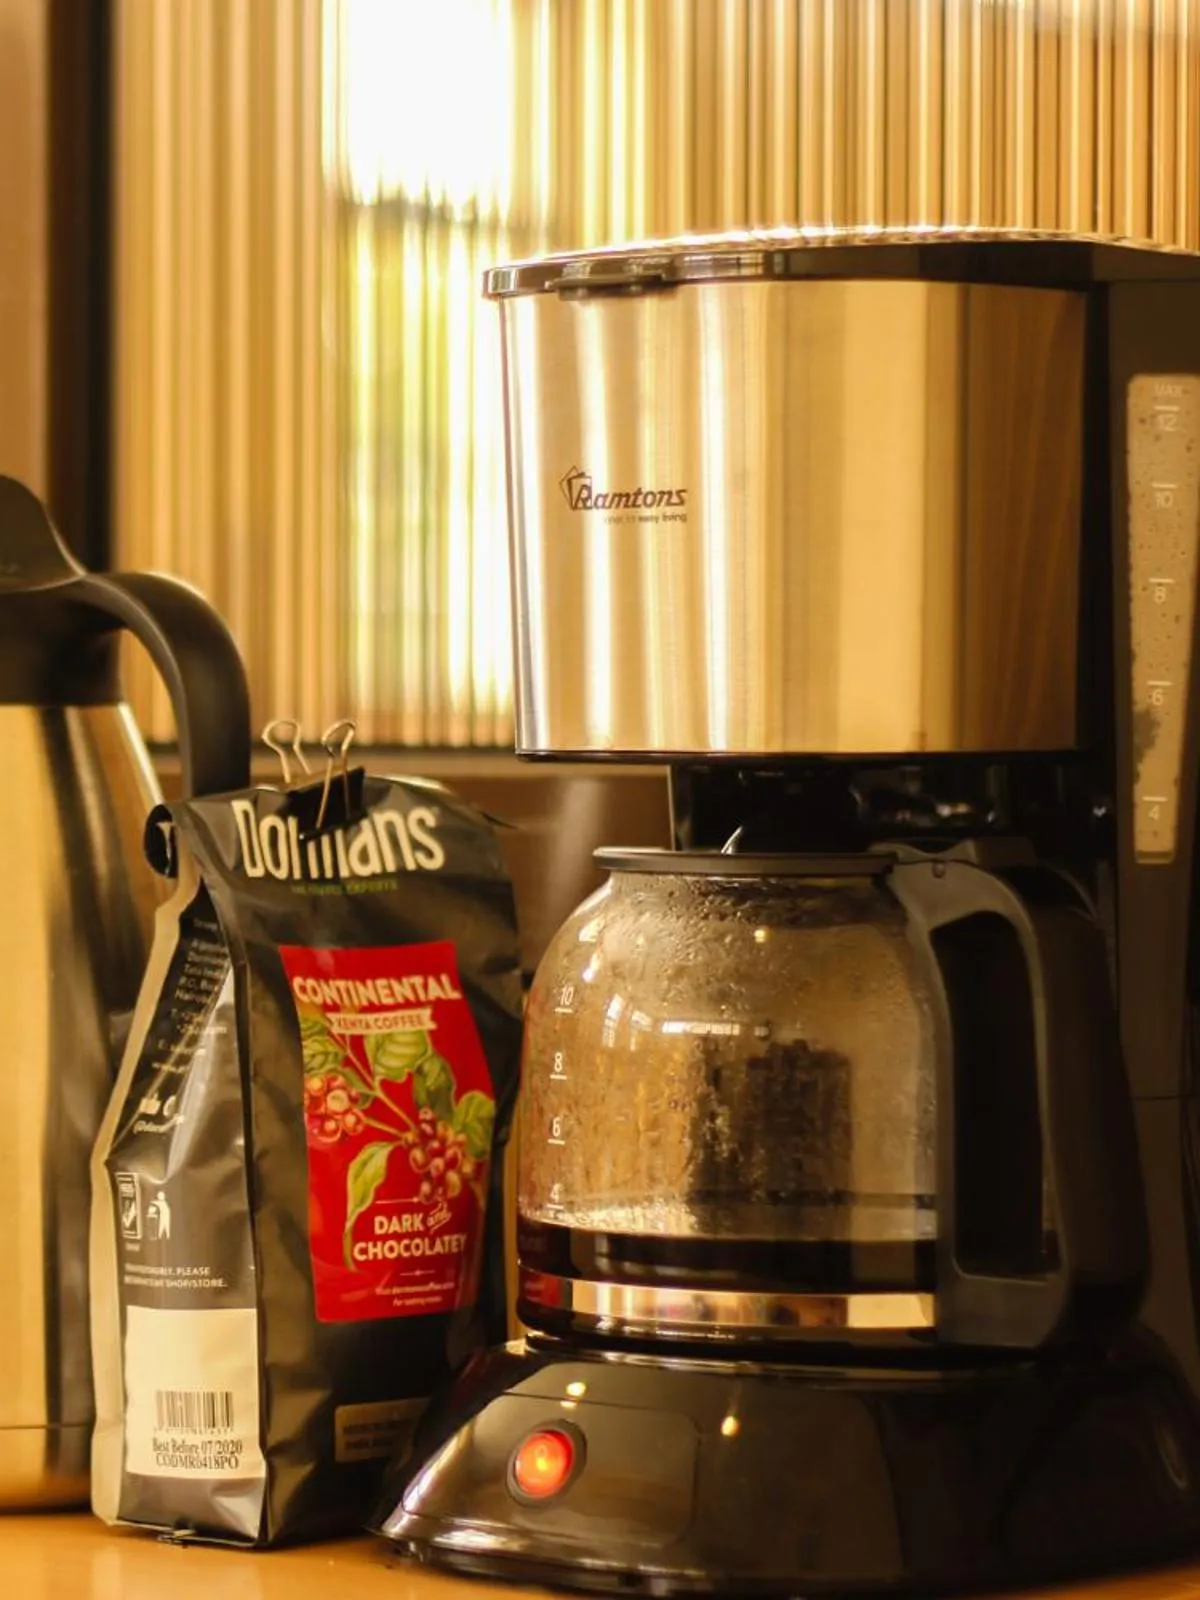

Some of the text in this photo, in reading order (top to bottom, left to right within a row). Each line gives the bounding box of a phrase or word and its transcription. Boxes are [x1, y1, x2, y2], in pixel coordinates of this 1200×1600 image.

[1157, 414, 1177, 432] 12
[573, 484, 687, 511] Ramtons
[1155, 491, 1173, 507] 10
[1154, 586, 1166, 604] 8
[1152, 689, 1164, 706] 6
[1149, 804, 1160, 820] 4
[292, 973, 462, 1006] CONTINENTAL
[560, 984, 574, 1005] 10
[373, 1013, 426, 1030] COFFEE
[554, 1052, 563, 1072] 8
[553, 1116, 561, 1137] 6
[374, 1213, 425, 1235] DARK
[353, 1234, 467, 1261] CHOCOLATEY
